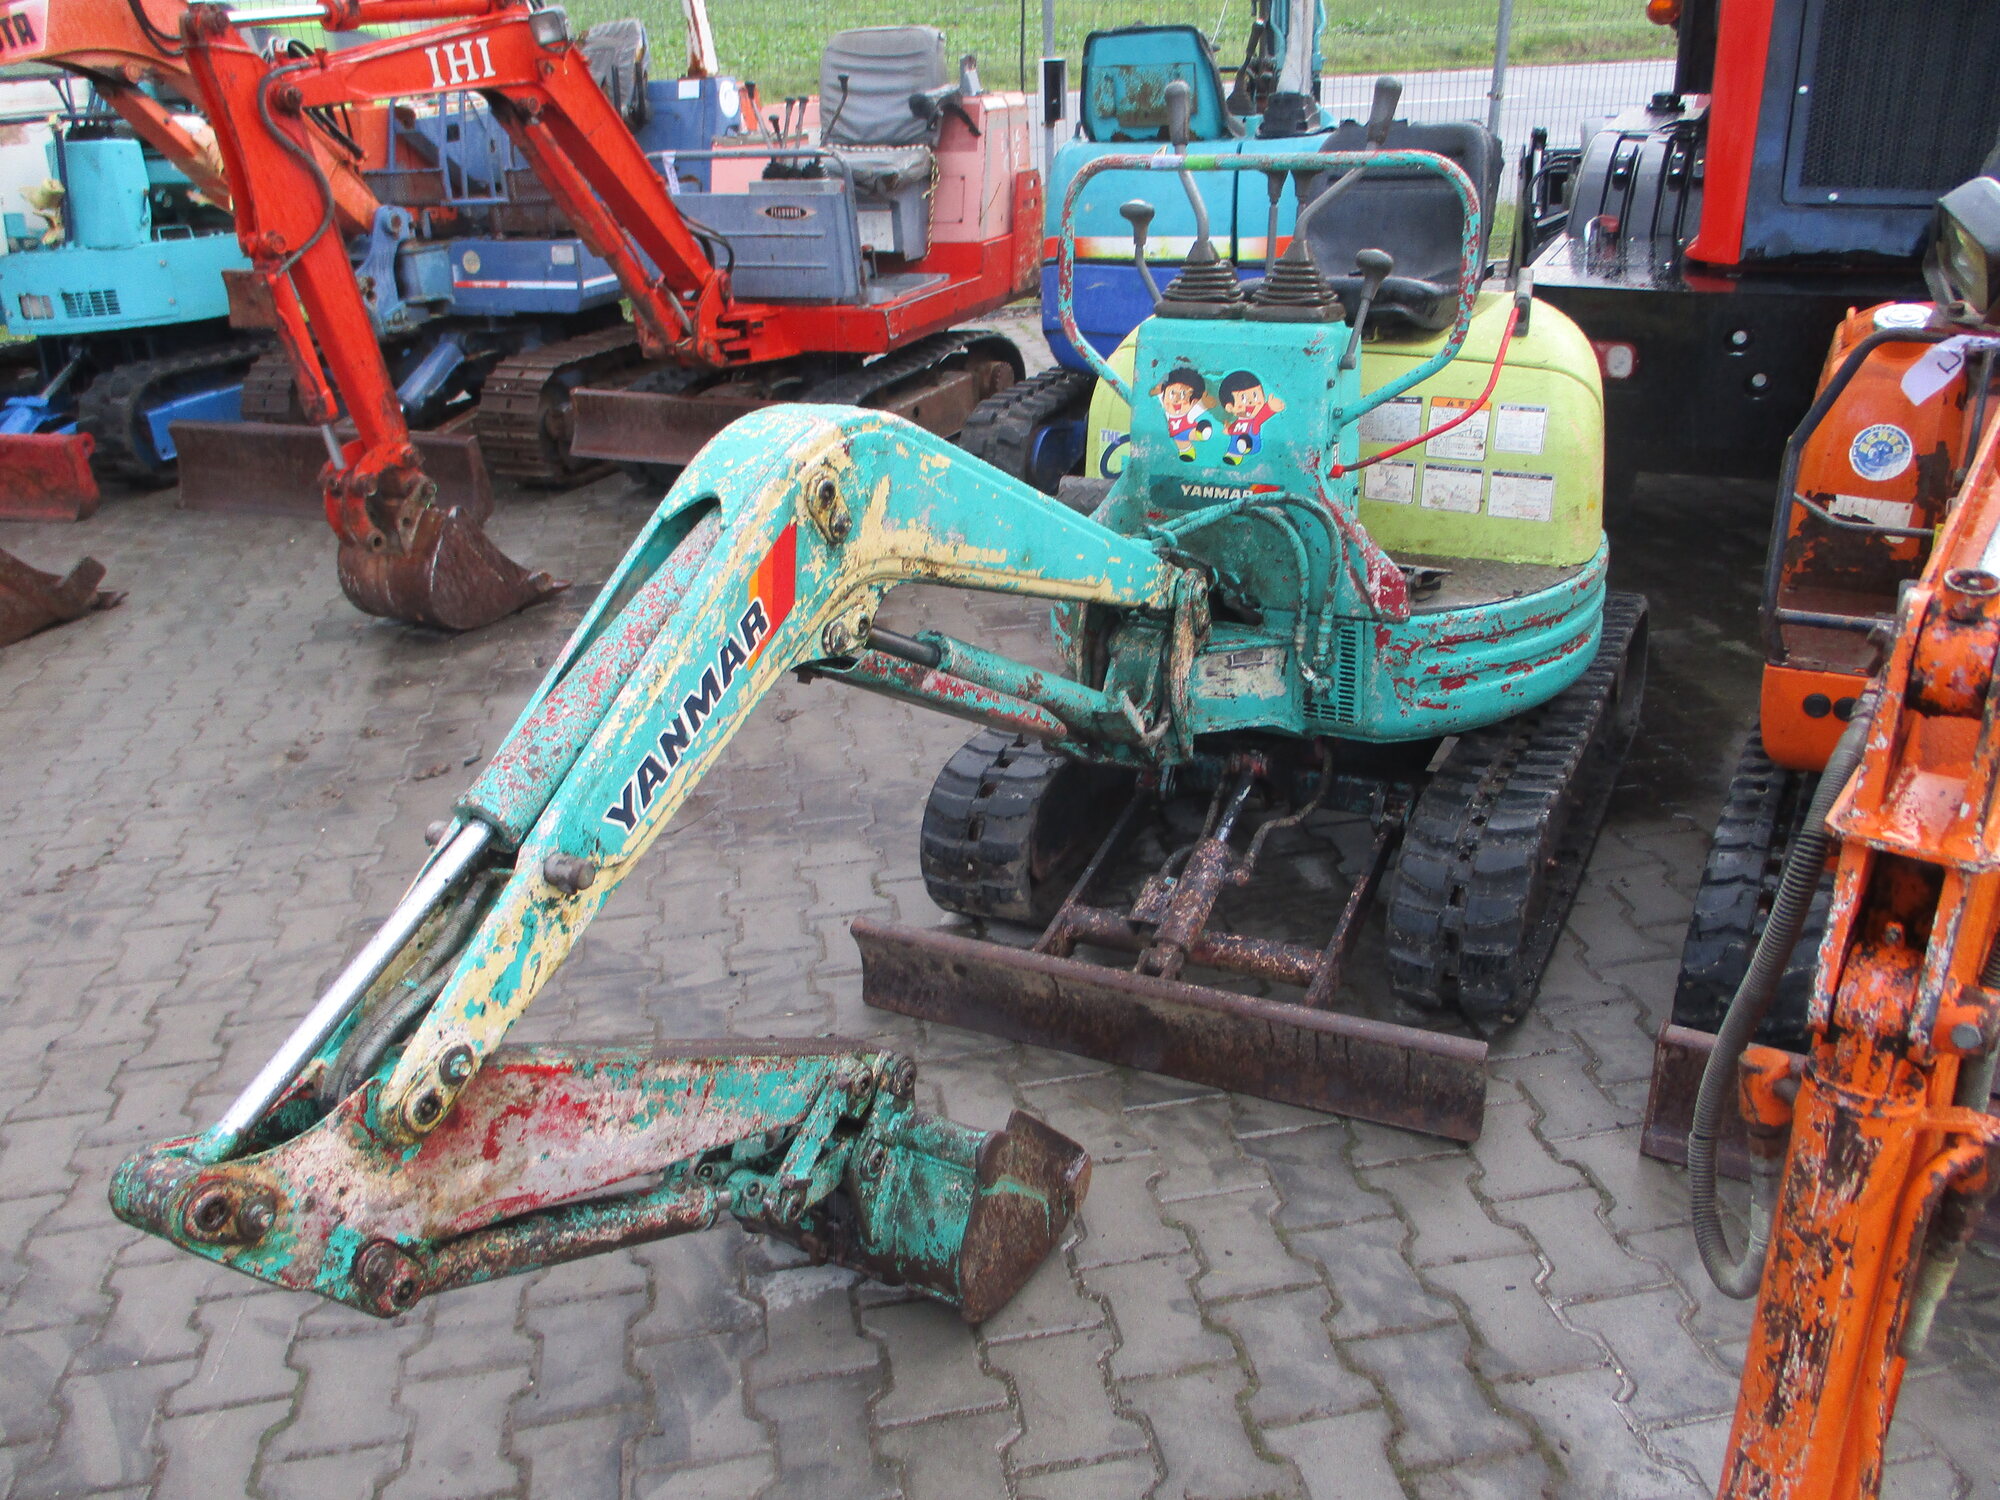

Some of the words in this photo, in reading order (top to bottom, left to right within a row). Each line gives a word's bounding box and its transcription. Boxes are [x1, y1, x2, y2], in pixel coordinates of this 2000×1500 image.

[0, 13, 37, 51] TA
[424, 37, 496, 88] IHI
[1170, 419, 1182, 431] Y
[1234, 422, 1249, 433] M
[604, 598, 769, 833] YANMAR
